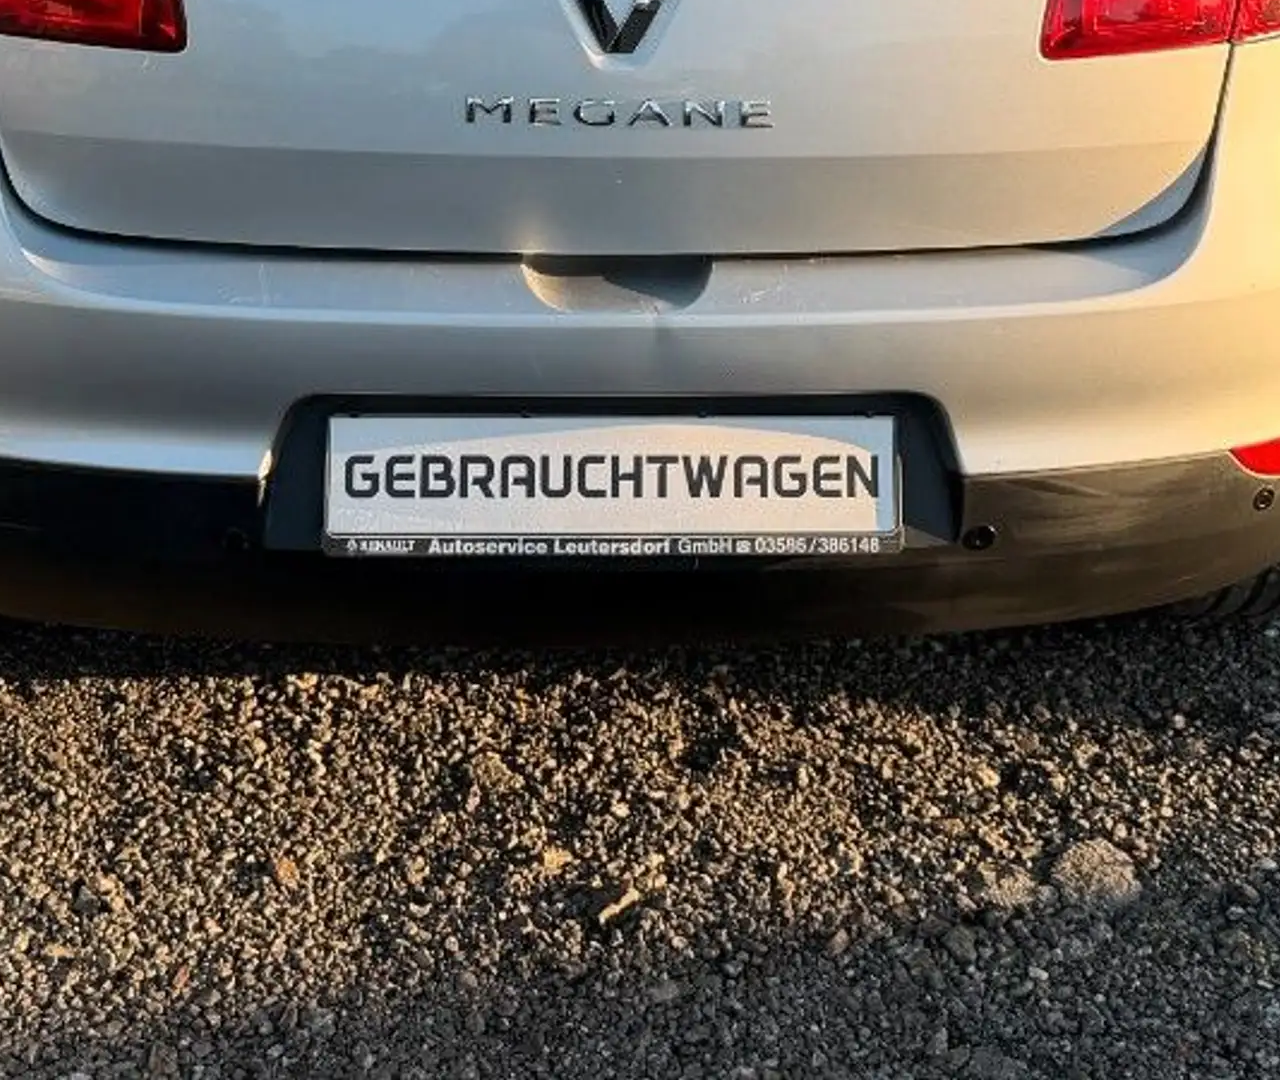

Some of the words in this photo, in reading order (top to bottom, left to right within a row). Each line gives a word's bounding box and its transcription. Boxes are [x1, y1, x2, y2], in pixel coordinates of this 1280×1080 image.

[464, 94, 774, 128] MEGANE
[344, 454, 880, 499] GEBRAUCHTWAGEN
[428, 538, 548, 555] Autoservice
[554, 538, 671, 555] Leutersdorf
[678, 538, 732, 554] GmbH
